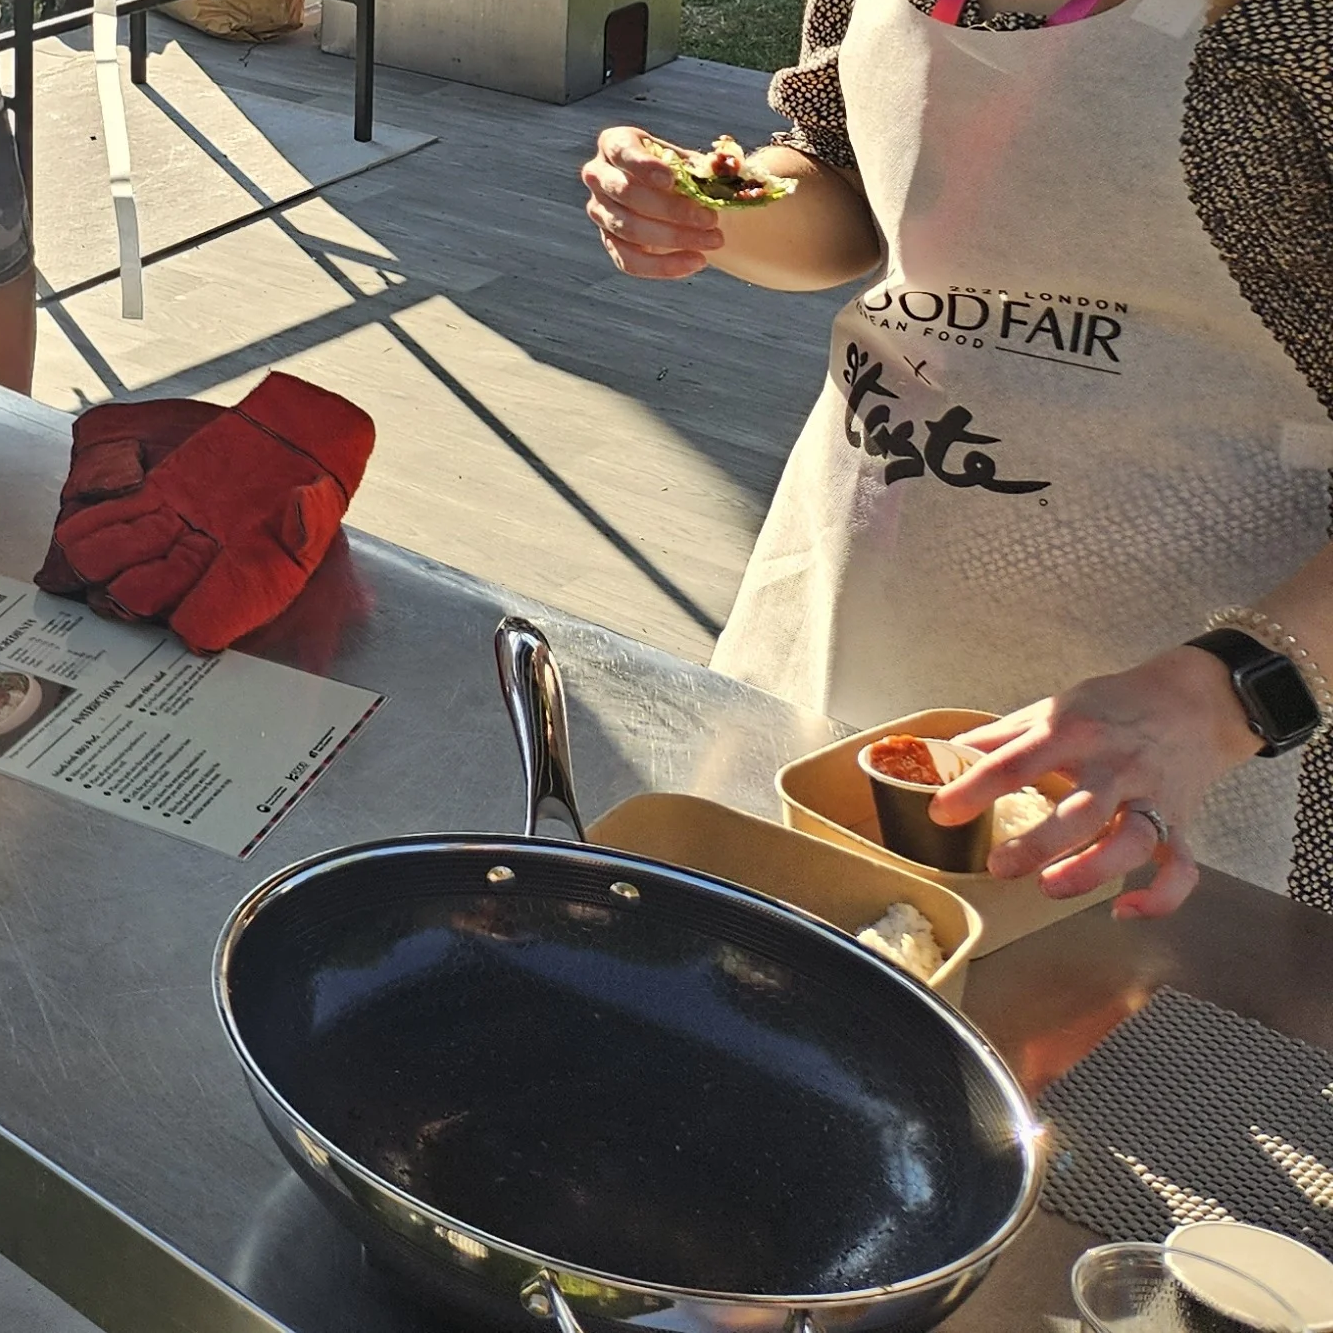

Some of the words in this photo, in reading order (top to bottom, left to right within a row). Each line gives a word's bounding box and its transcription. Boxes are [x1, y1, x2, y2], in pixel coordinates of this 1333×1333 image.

[1025, 291, 1129, 314] LONDON
[863, 291, 990, 331] OOD
[1000, 300, 1121, 363] FAIR
[923, 327, 984, 349] FOOD
